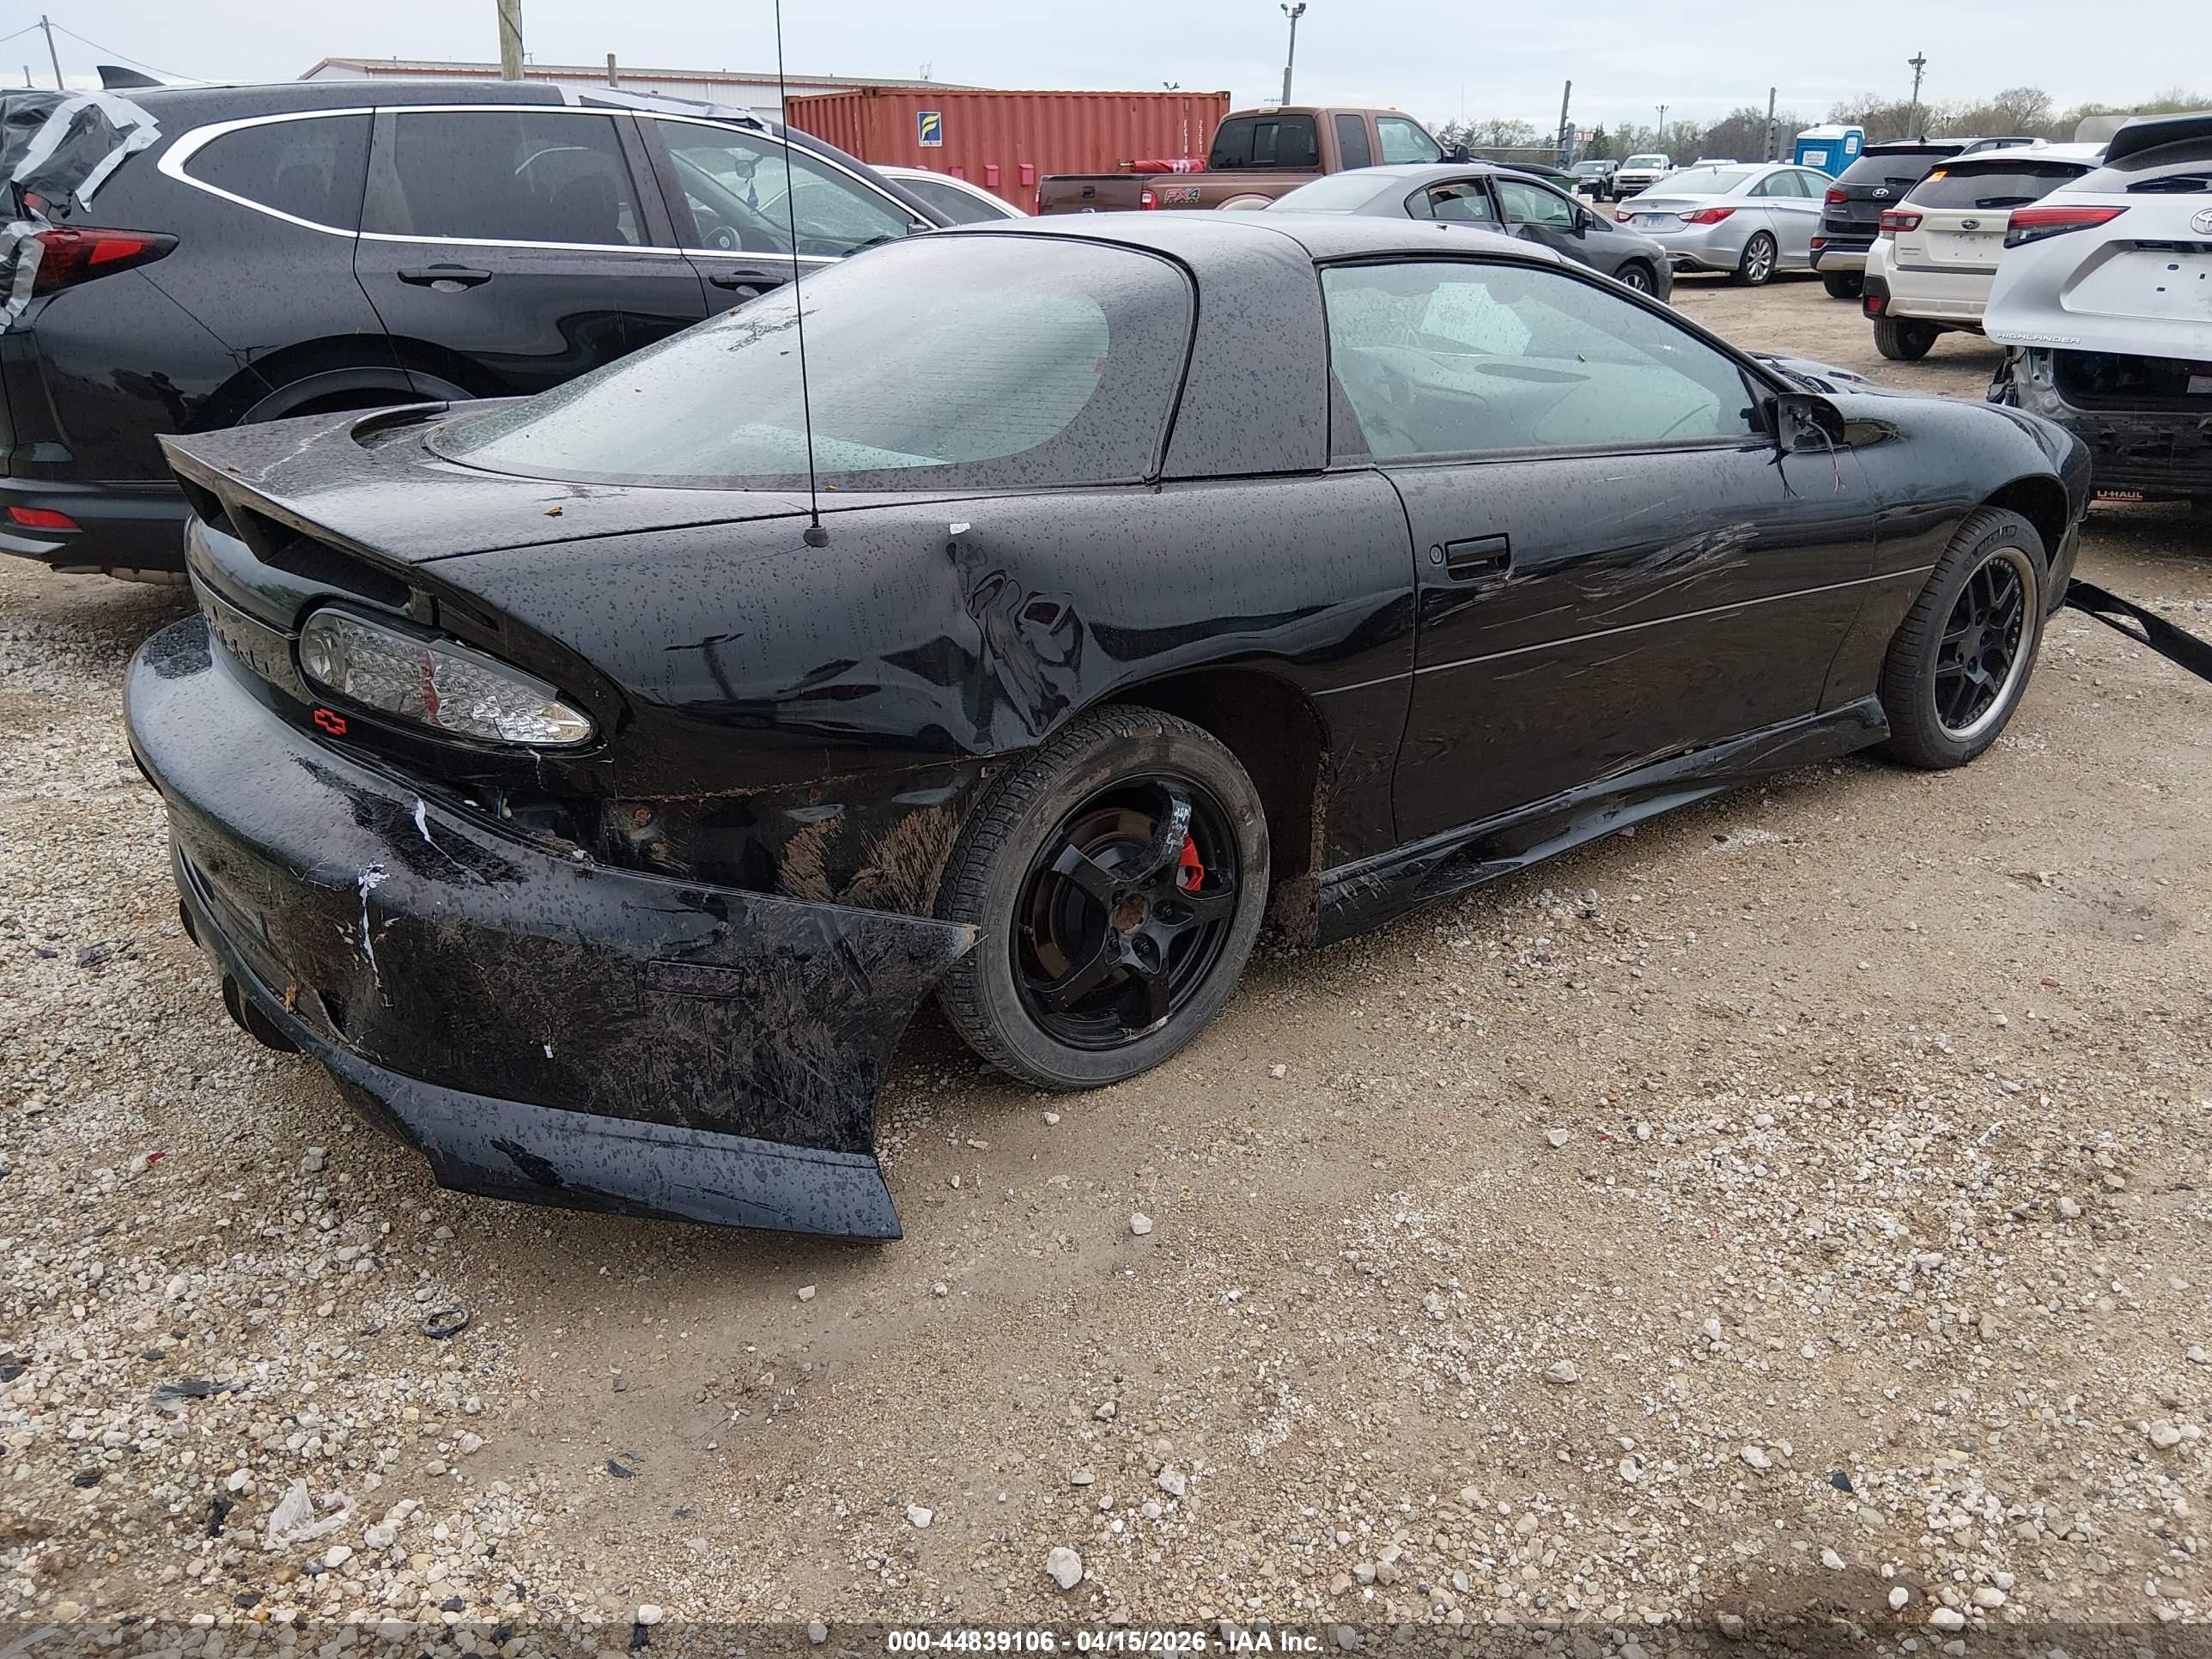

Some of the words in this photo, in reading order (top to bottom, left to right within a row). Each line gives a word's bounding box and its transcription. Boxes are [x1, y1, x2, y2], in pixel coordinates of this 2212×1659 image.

[1164, 186, 1201, 201] FX4
[1996, 331, 2081, 344] HIGHLANDER
[1977, 526, 2017, 554] MICHLIN
